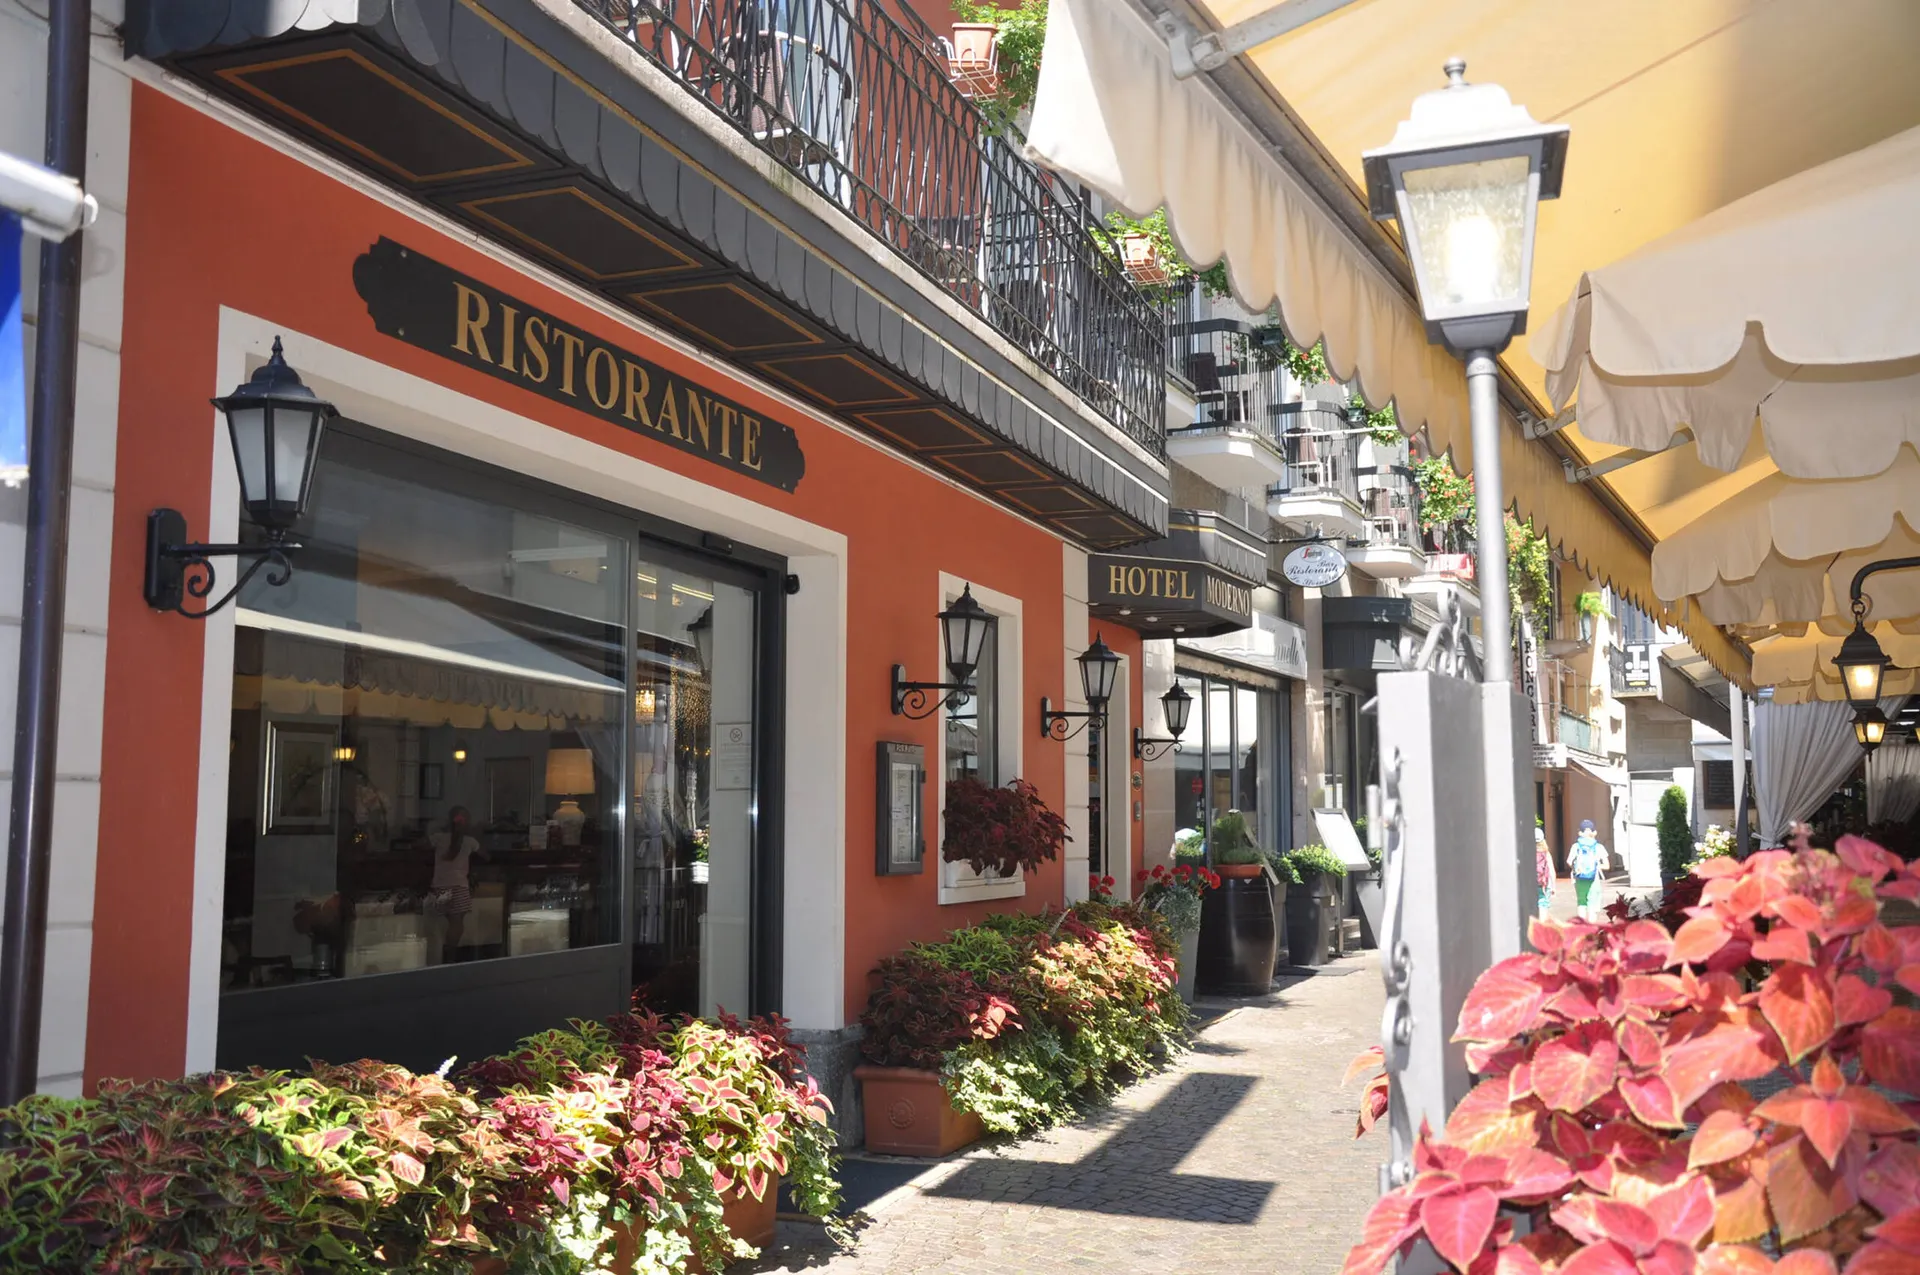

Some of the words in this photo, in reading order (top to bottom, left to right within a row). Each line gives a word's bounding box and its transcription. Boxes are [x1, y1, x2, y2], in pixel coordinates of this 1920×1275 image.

[451, 281, 764, 472] RISTORANTE
[1108, 564, 1196, 600] HOTEL
[1206, 574, 1250, 617] MODERNO
